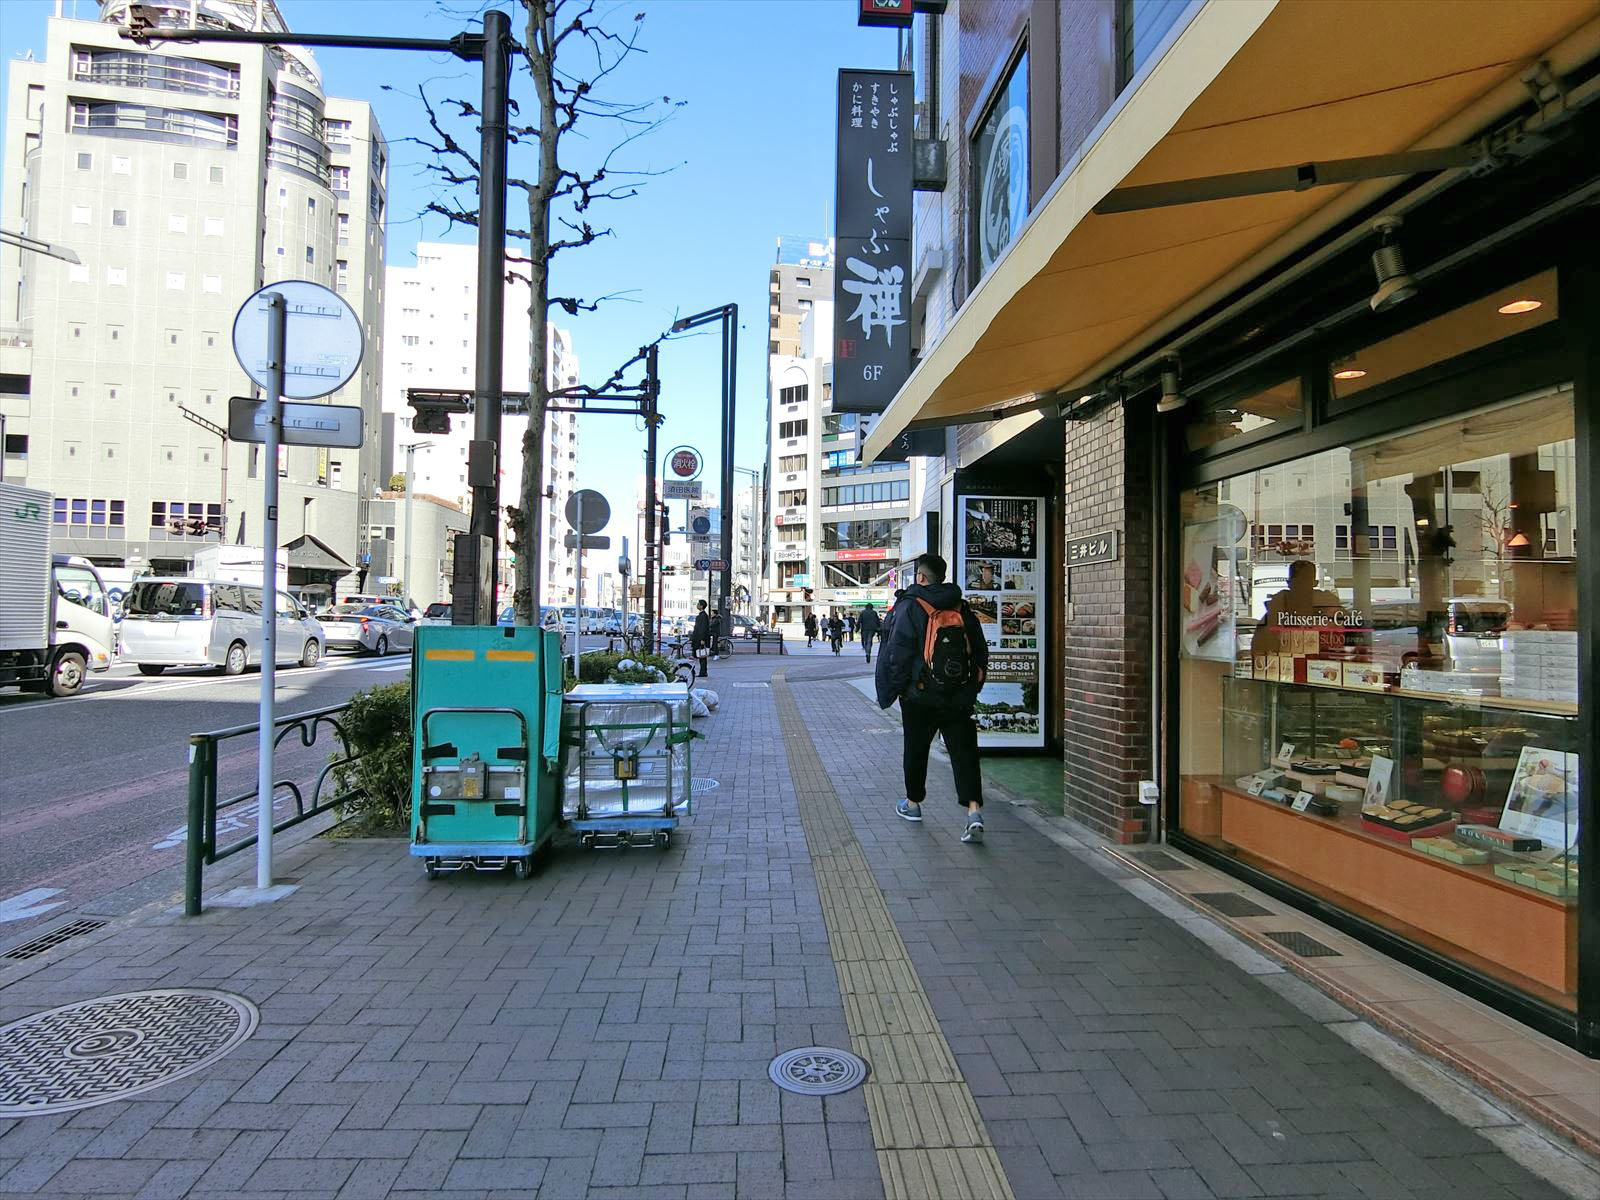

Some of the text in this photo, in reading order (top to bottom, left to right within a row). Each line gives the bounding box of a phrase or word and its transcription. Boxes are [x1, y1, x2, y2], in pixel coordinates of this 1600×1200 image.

[850, 82, 863, 128] かに料理
[869, 82, 880, 129] すきやき
[887, 83, 899, 153] しゃぶしゃぶ
[863, 365, 883, 381] 6F
[673, 458, 696, 470] 消火栓
[14, 501, 41, 520] JR
[1070, 539, 1108, 560] 三井ビル
[701, 560, 710, 568] 20
